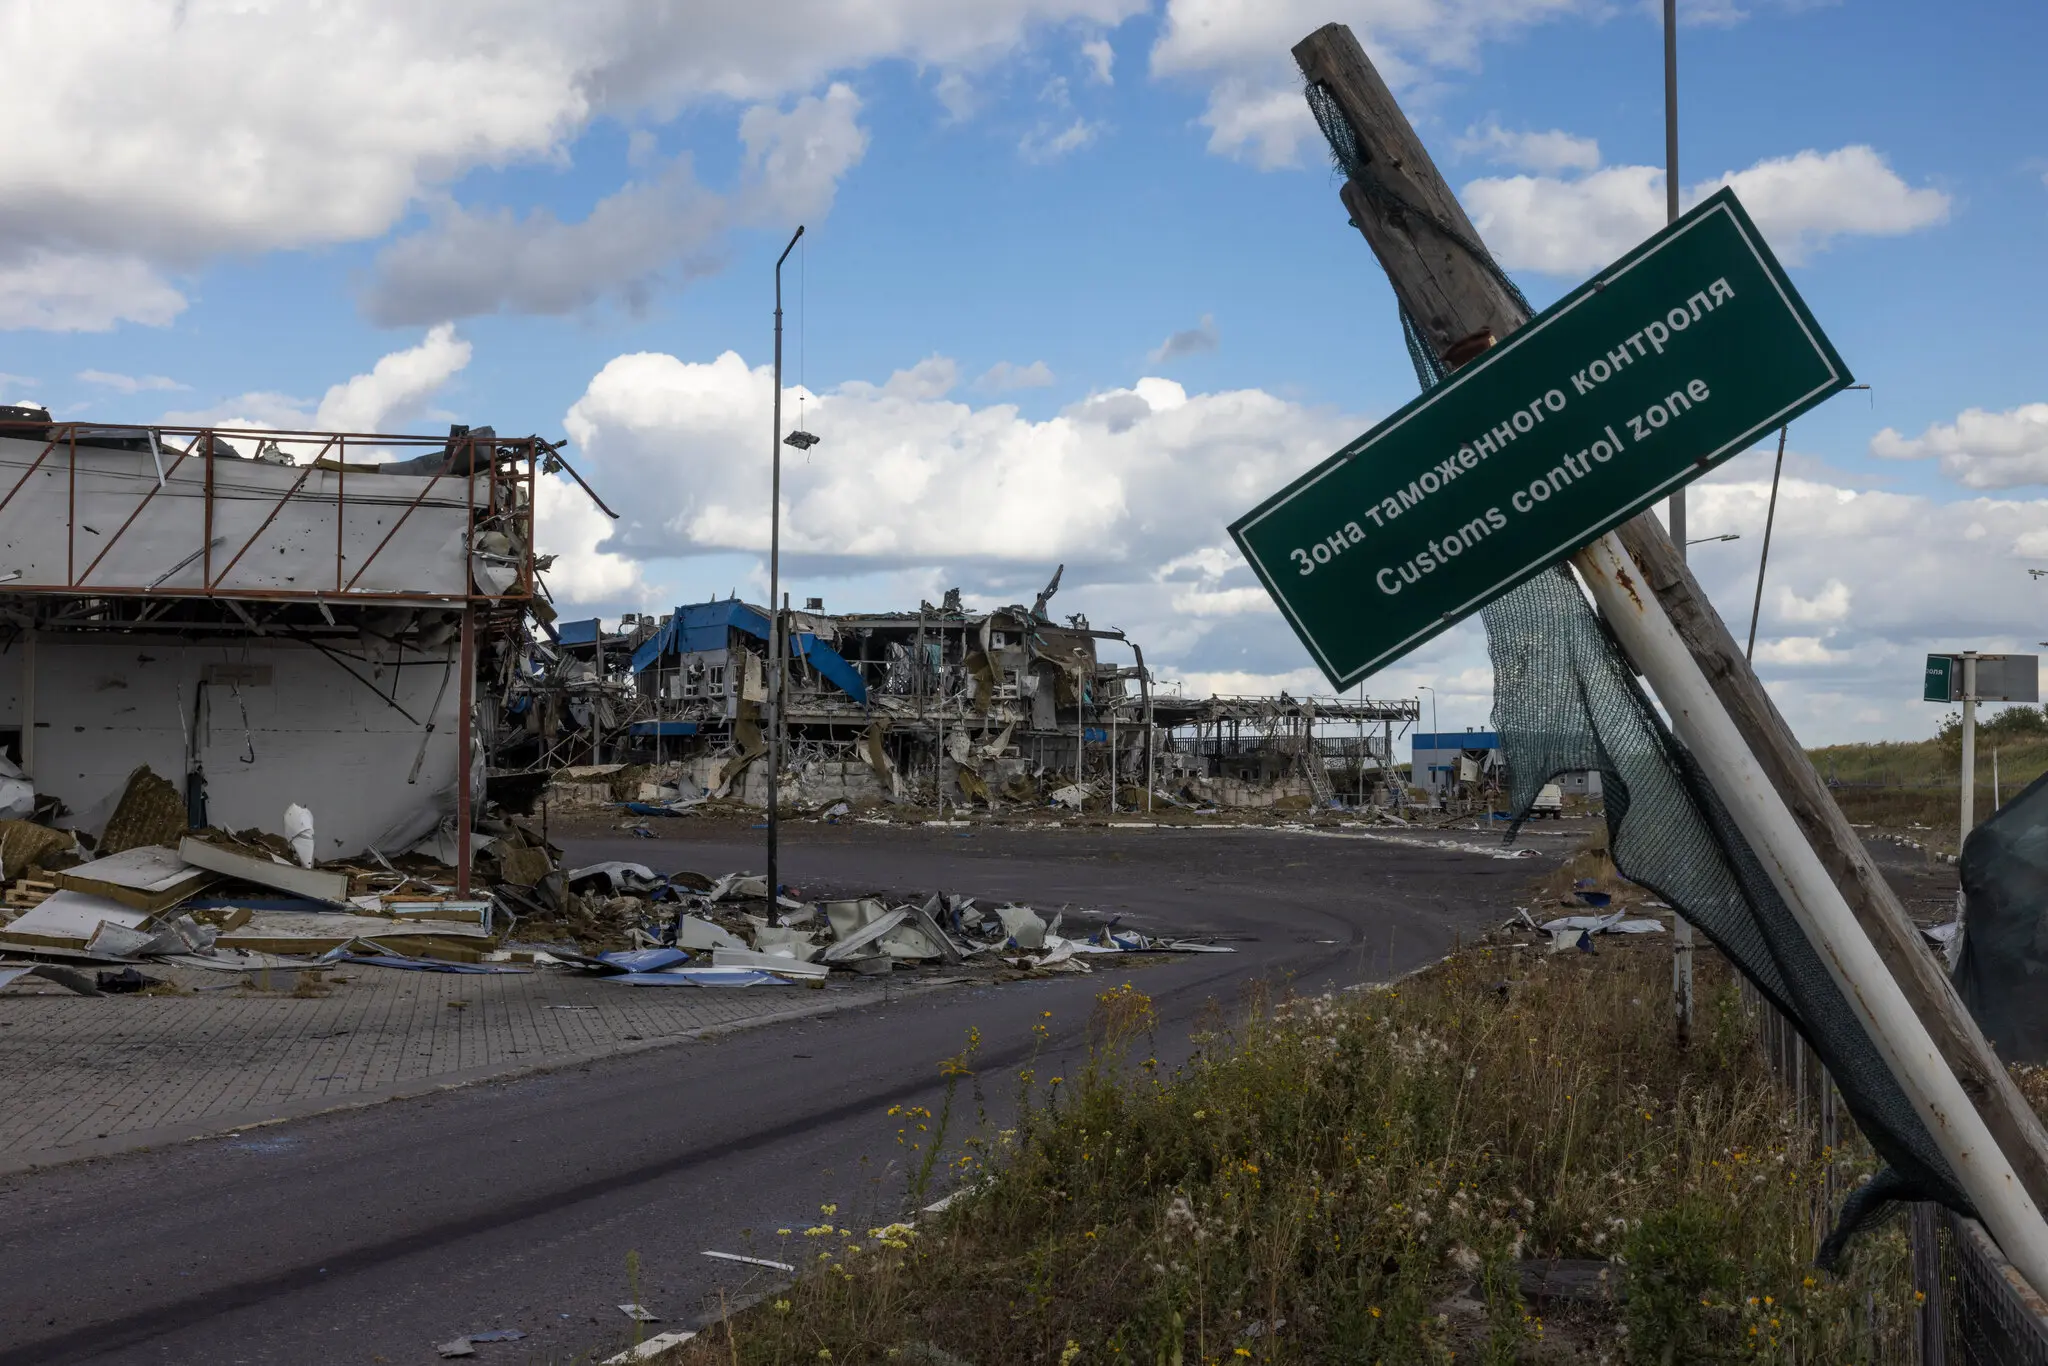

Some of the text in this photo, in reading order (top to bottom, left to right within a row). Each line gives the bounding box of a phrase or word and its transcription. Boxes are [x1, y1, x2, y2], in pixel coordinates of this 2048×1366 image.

[1290, 277, 1735, 576] Зона таможенного контроля
[1376, 379, 1711, 596] Customs control zone
